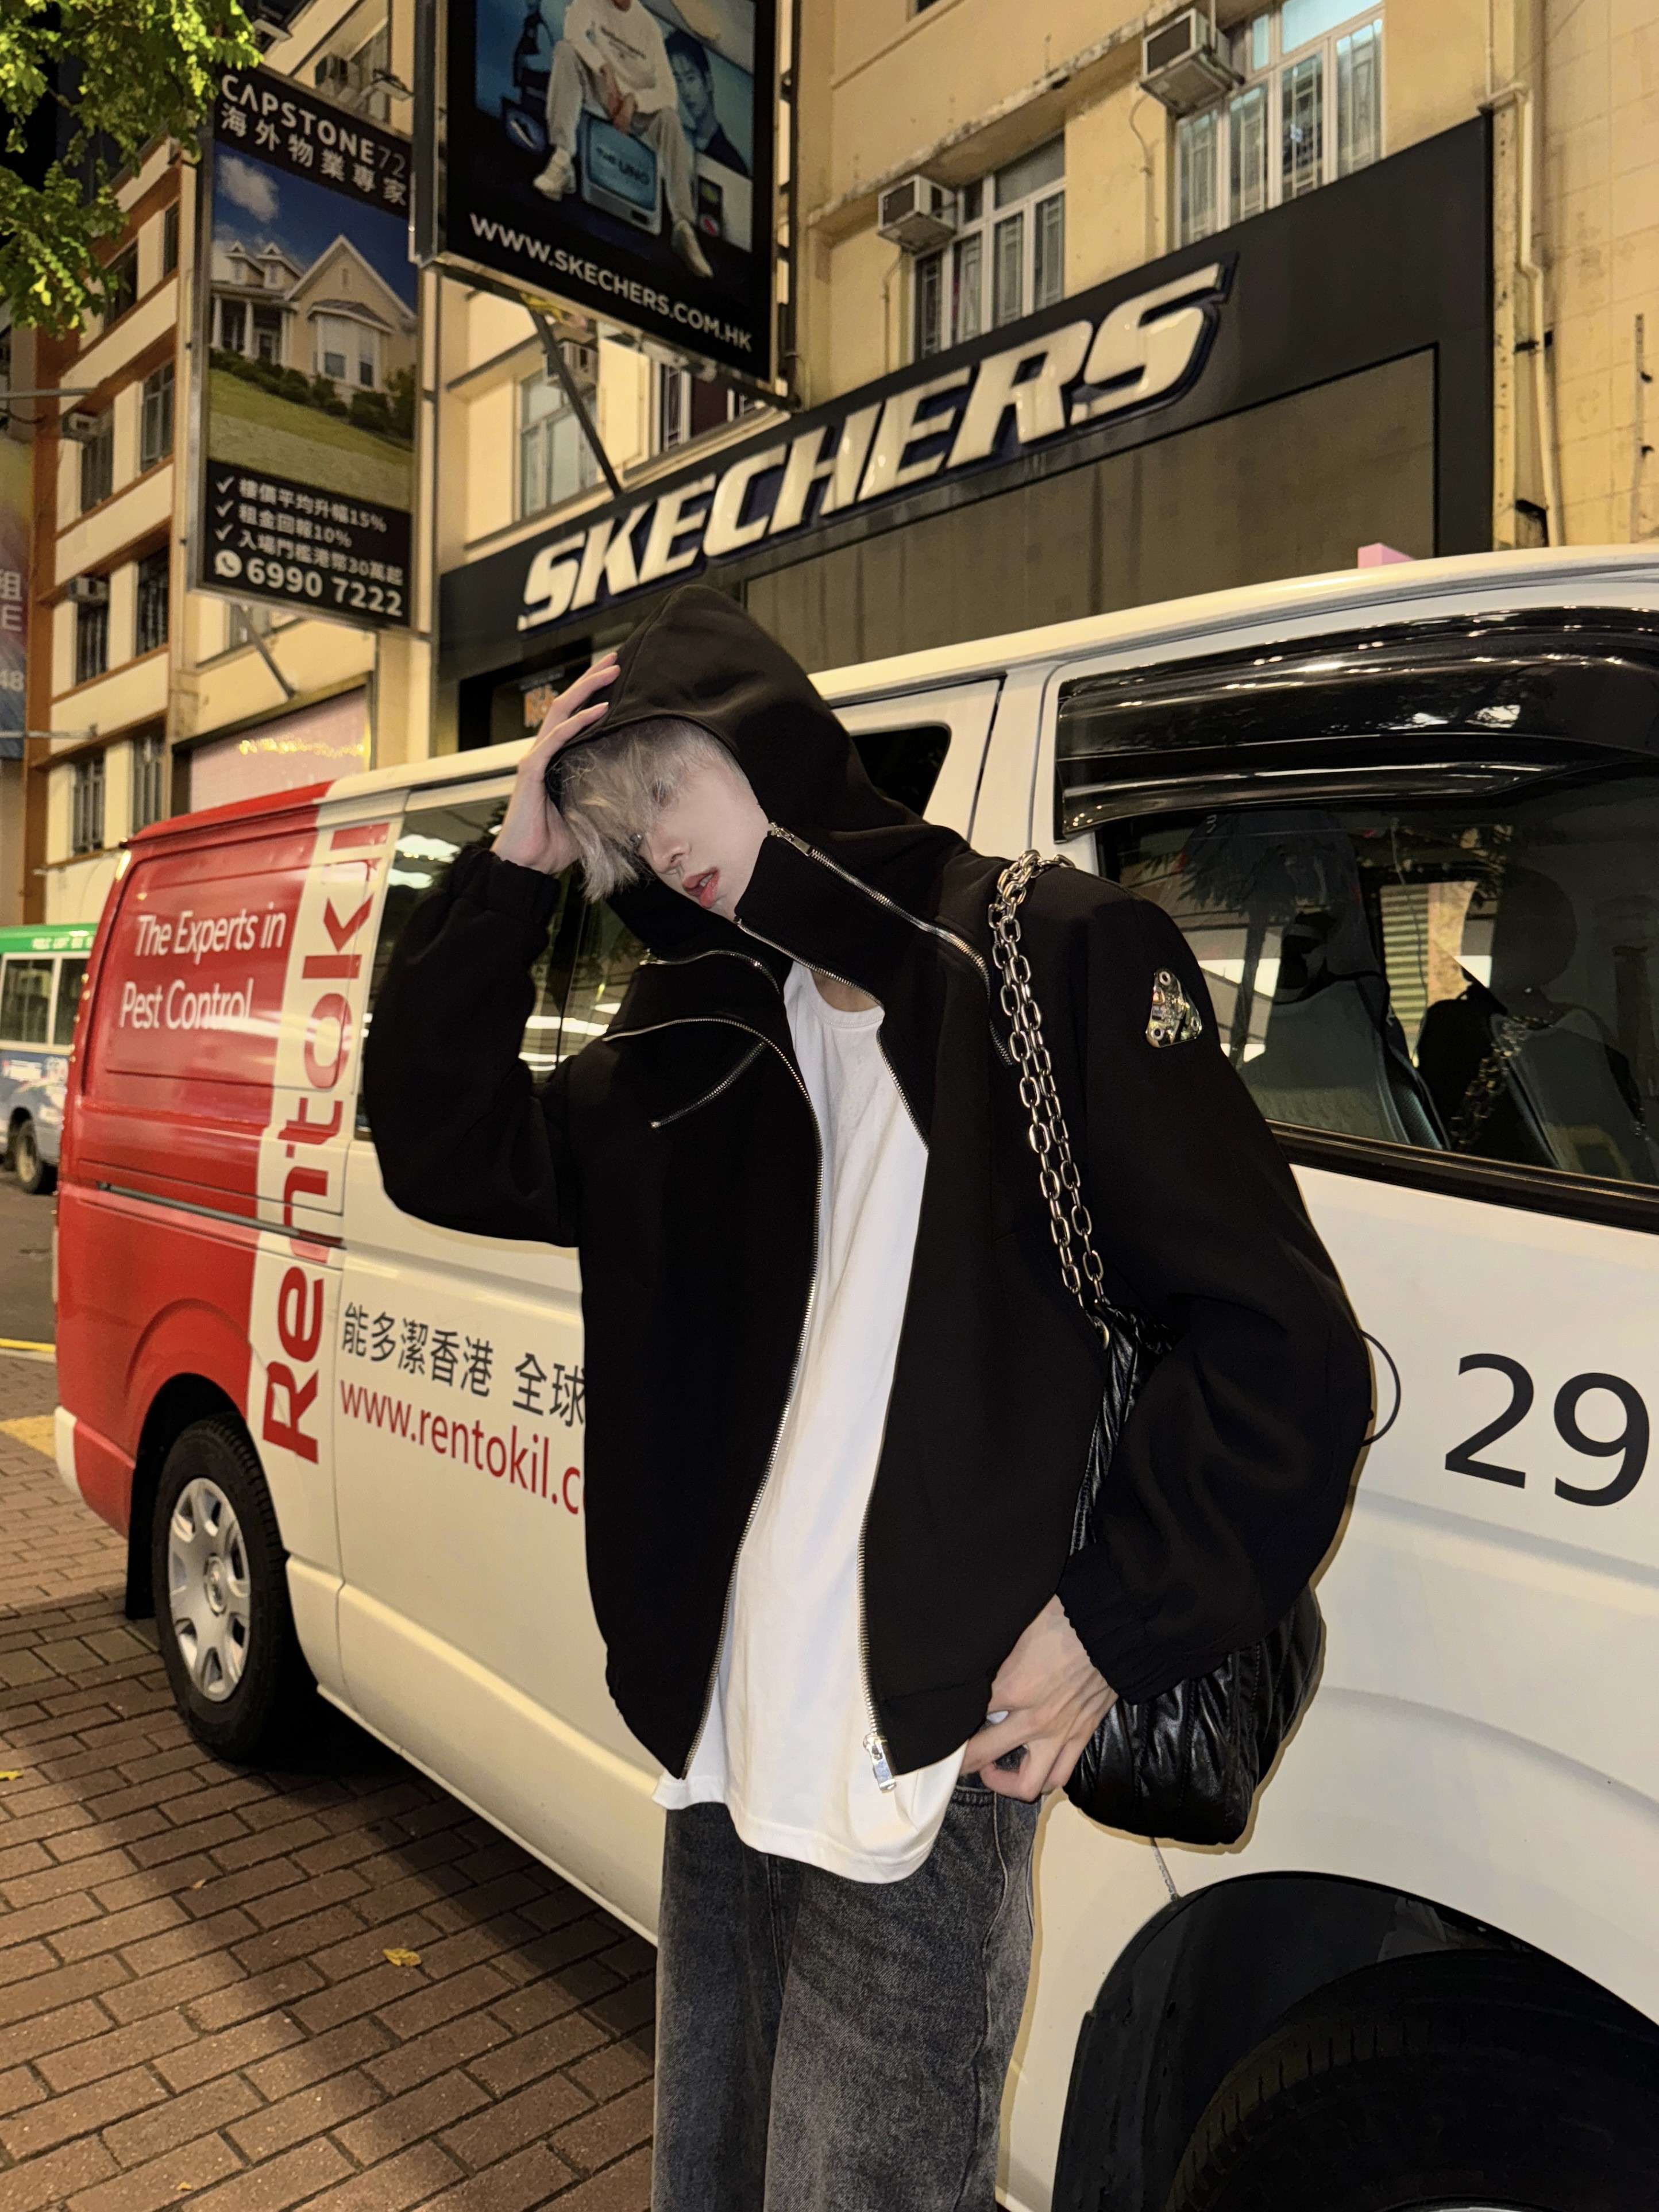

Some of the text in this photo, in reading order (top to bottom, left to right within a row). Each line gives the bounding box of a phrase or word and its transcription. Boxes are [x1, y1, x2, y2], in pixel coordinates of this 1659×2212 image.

[221, 103, 407, 206] 海外物業專家
[469, 213, 752, 352] WWW.SKECHERS.COM.HK
[516, 259, 1230, 633] SKECHERS
[238, 503, 352, 548] 租金回報10%
[246, 557, 402, 617] 6990 7222
[135, 902, 286, 965] The Experts in
[119, 978, 254, 1030] Pest Control
[263, 822, 391, 1465] Rentokil
[342, 1302, 585, 1428] 能多潔香港 全球
[340, 1379, 585, 1515] www.rentokil.c
[1444, 1353, 1650, 1506] 29
